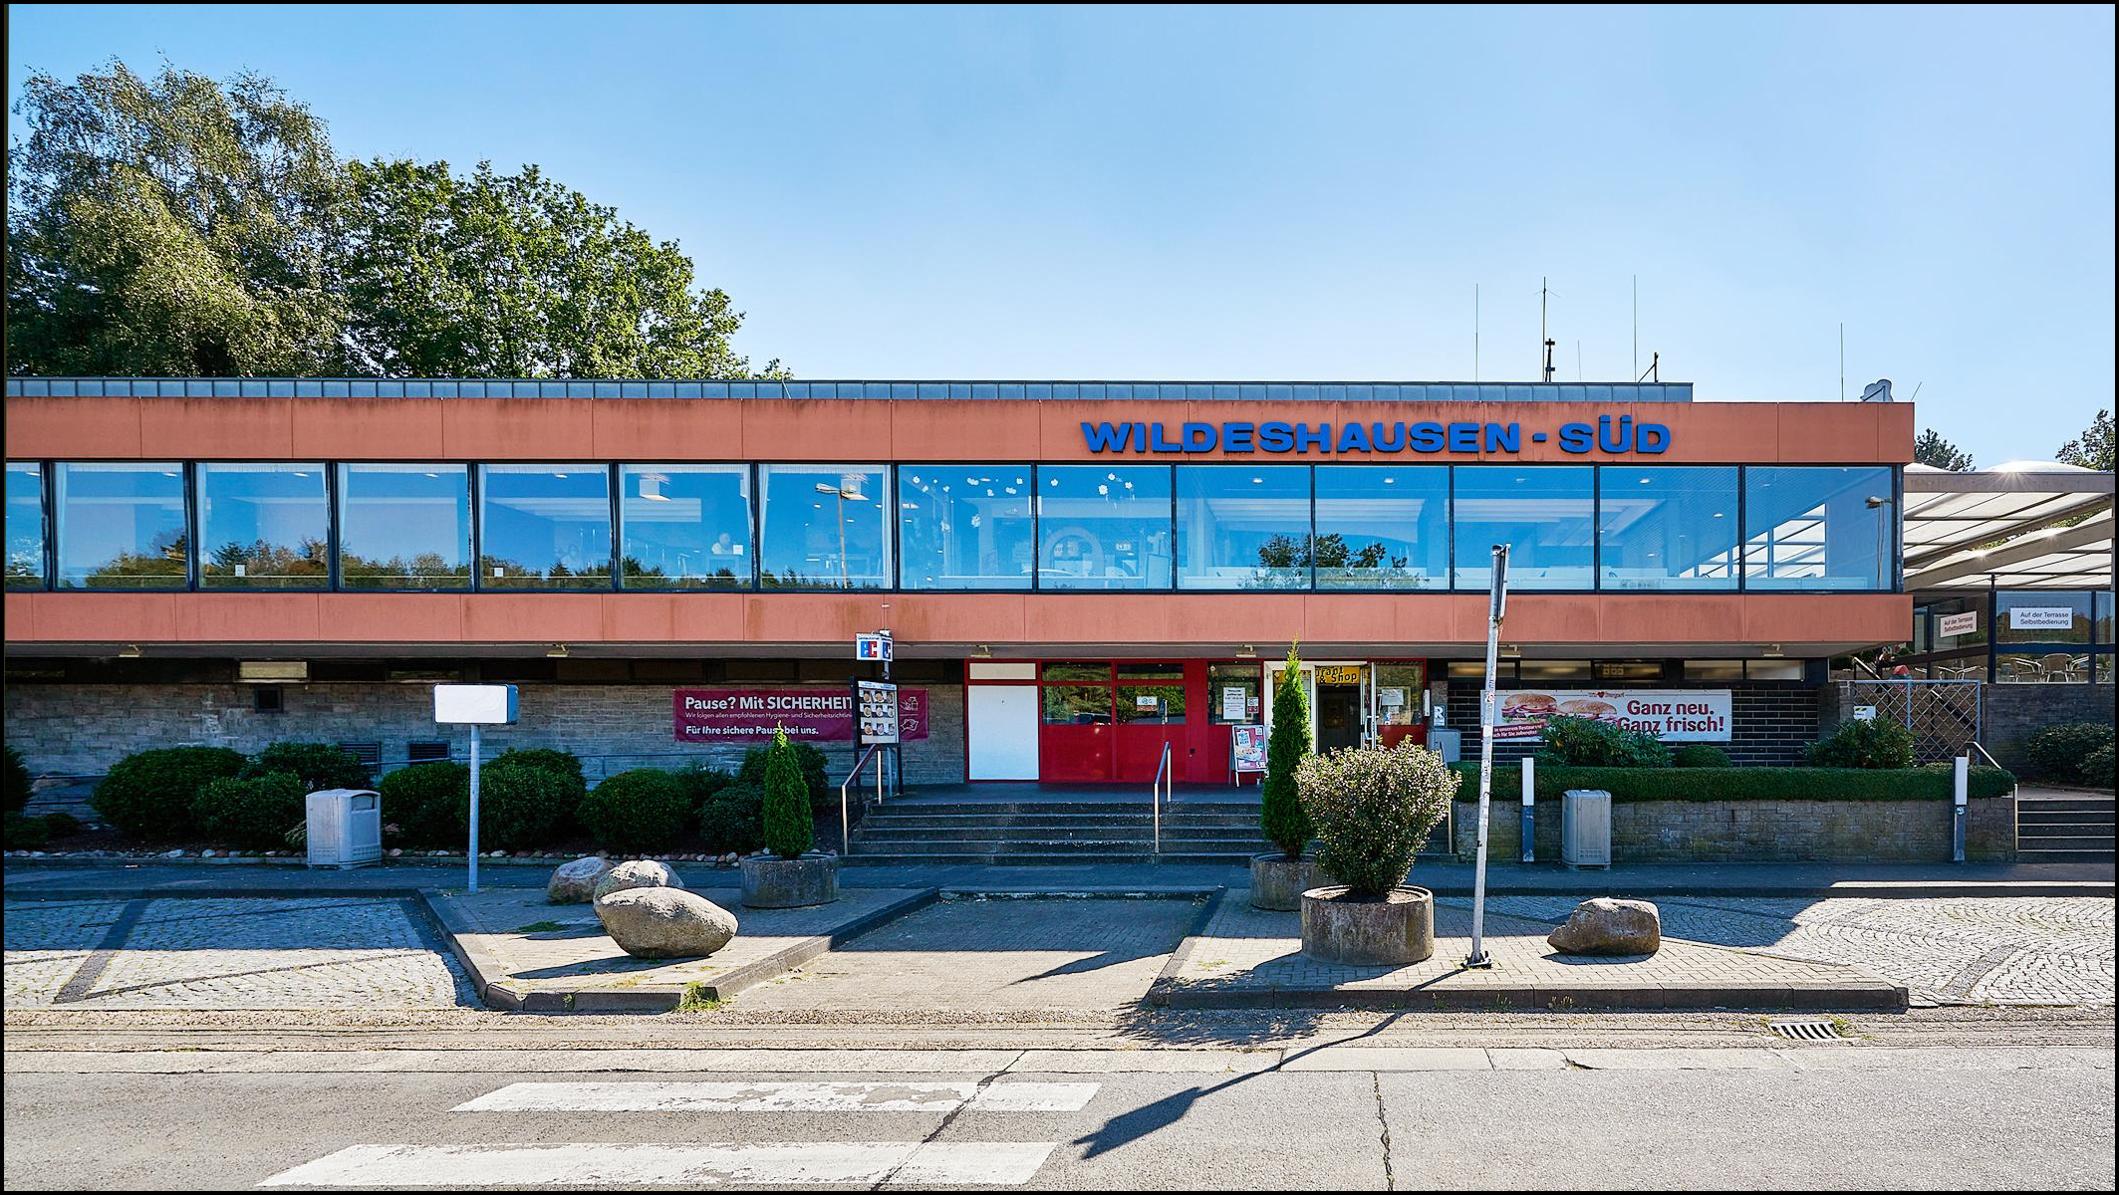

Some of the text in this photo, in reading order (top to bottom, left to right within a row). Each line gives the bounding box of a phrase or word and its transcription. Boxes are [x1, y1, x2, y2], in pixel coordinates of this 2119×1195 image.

[1081, 415, 1671, 454] WILDESHAUSEN - SÜD
[1331, 672, 1357, 683] Shop
[685, 696, 736, 709] Pause?
[740, 696, 764, 709] Mit
[1627, 700, 1714, 715] Ganz neu.
[697, 712, 714, 720] folgen
[730, 712, 765, 720] empfohlenen
[686, 725, 819, 734] Für Ihre sichere Paus bei uns.
[1617, 716, 1724, 732] Ganz frisch!
